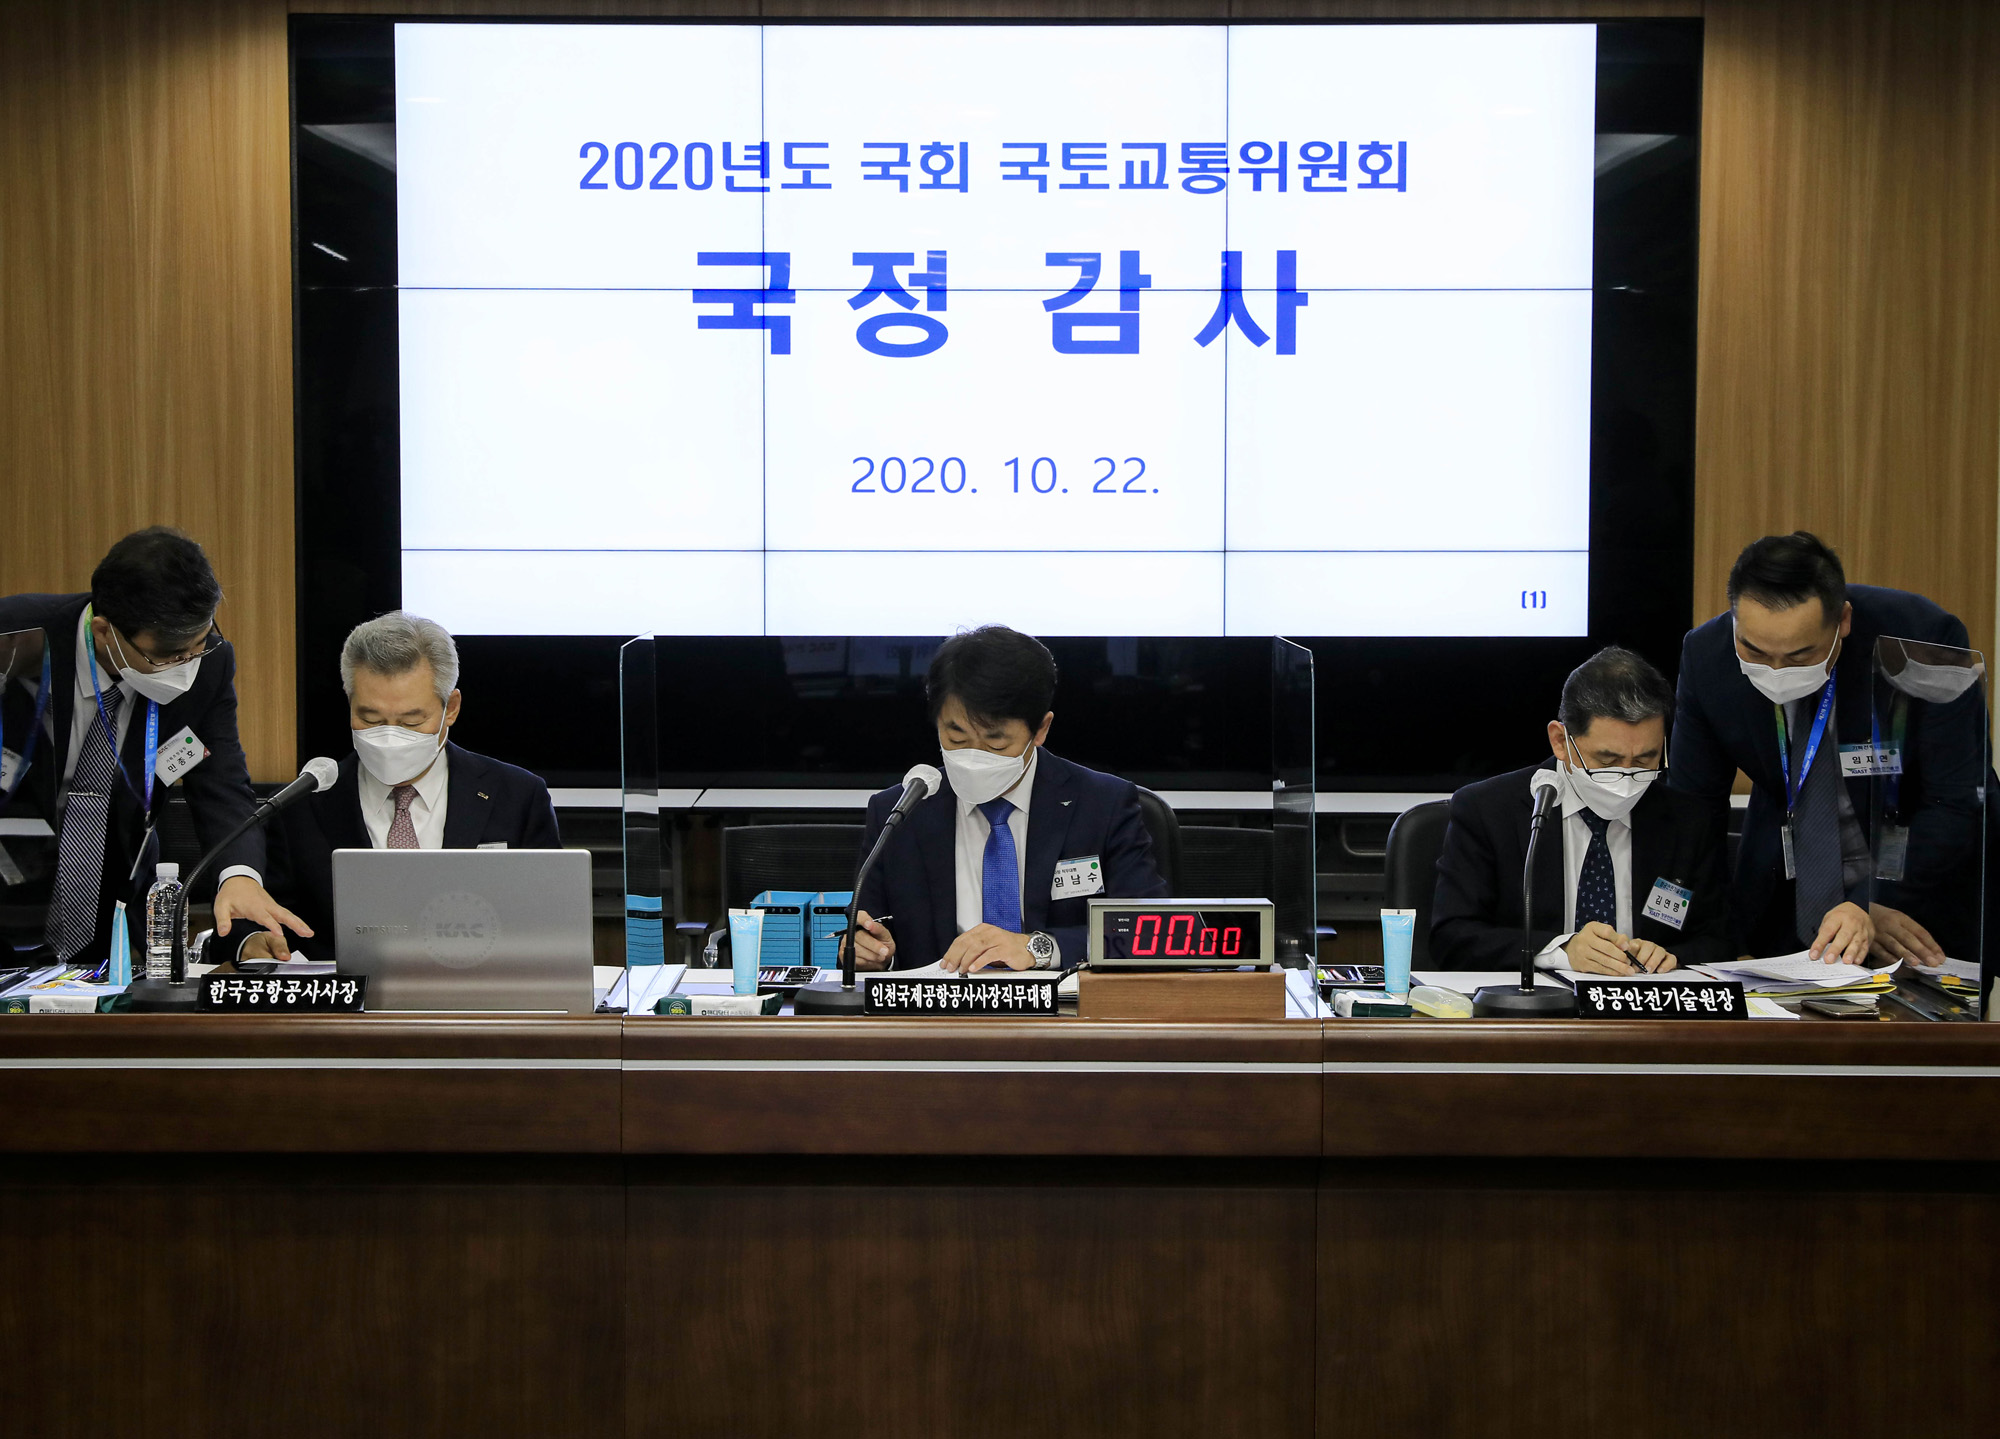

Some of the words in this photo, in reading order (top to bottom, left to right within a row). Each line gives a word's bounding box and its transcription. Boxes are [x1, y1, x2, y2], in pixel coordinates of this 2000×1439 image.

[579, 141, 832, 193] 2020년도
[860, 141, 969, 193] 국회
[999, 140, 1408, 194] 국토교통위원회
[851, 456, 978, 494] 2020.
[1004, 456, 1069, 494] 10.
[1092, 456, 1159, 494] 22.
[1053, 872, 1098, 888] 임남수
[436, 922, 484, 939] KAC
[209, 979, 358, 1004] 한국공항공사사장
[871, 983, 1052, 1009] 인천국제공항공사사장직무대행
[1587, 986, 1735, 1012] 항공안전기술원장
